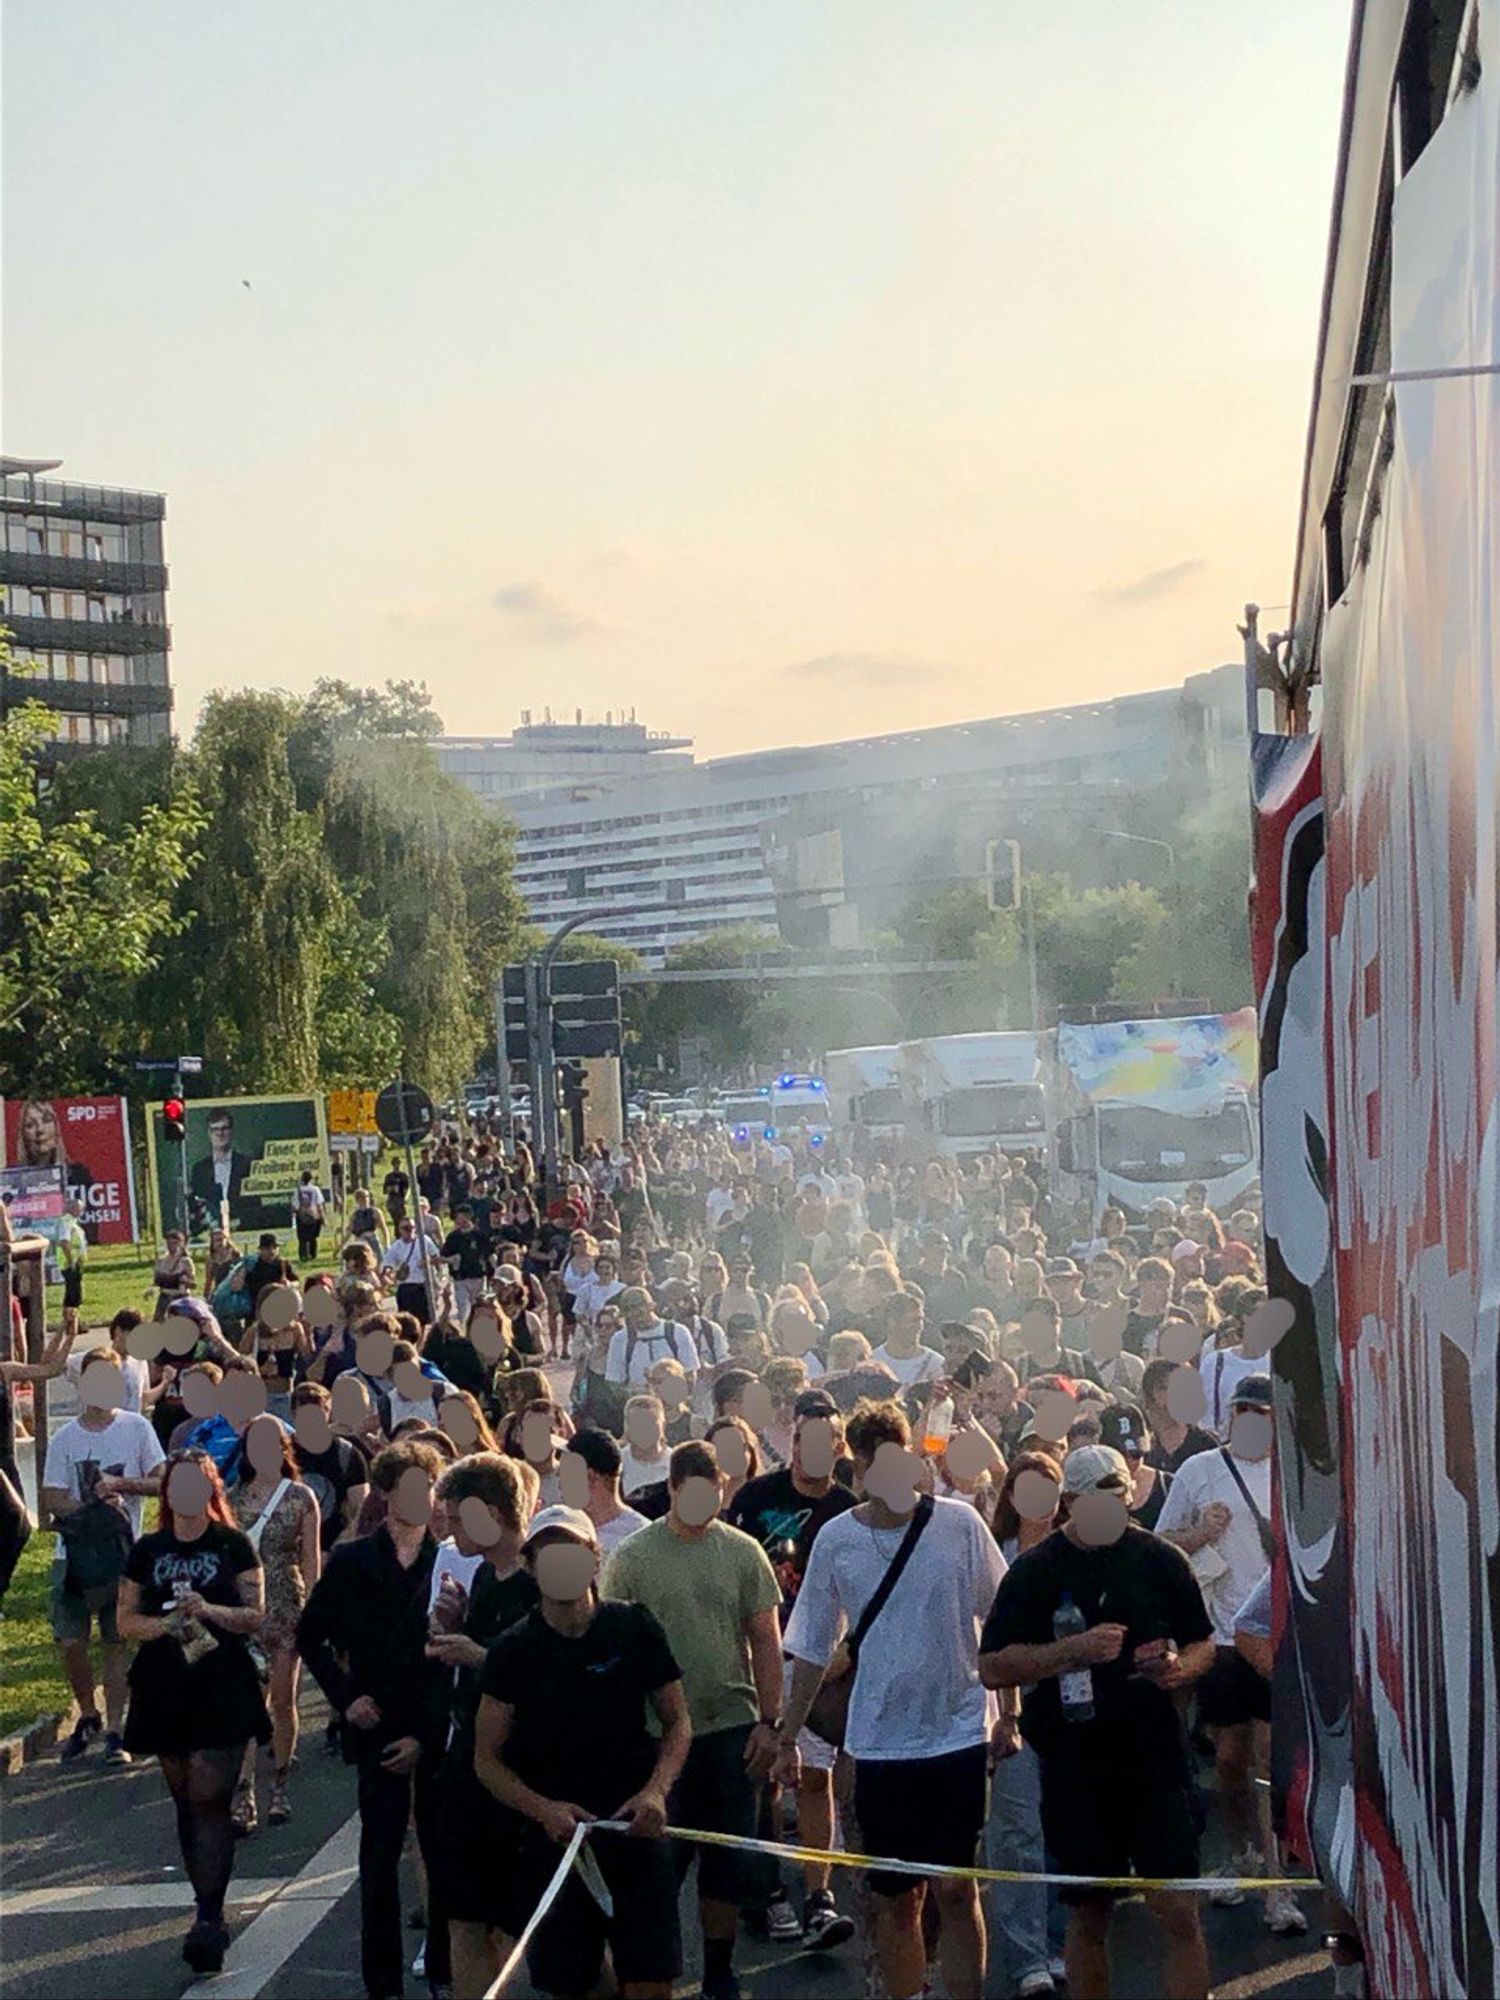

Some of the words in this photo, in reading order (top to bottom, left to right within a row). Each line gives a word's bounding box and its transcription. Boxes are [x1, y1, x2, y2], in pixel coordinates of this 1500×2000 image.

[67, 1106, 96, 1121] SPD
[65, 1183, 120, 1207] TIGE
[153, 1552, 220, 1585] CHAOS
